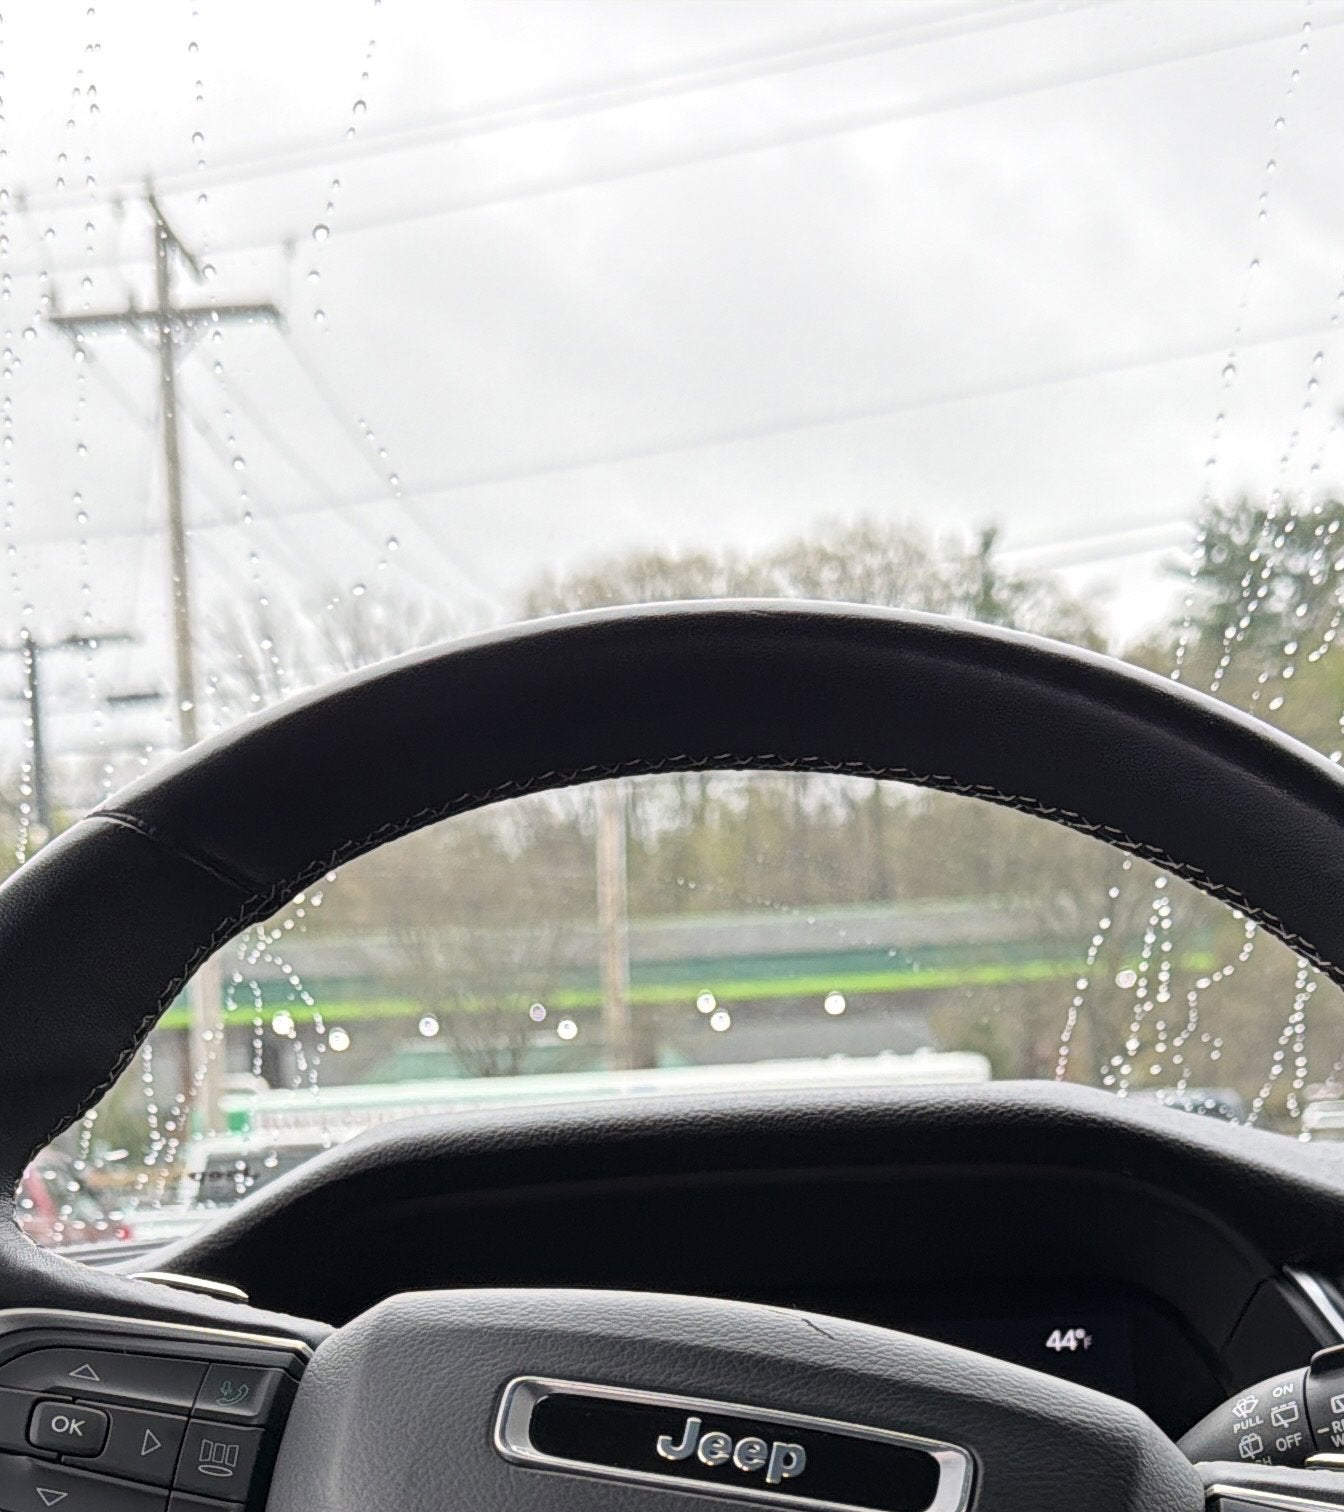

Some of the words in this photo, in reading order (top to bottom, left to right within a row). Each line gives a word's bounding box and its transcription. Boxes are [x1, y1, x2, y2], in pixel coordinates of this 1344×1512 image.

[1272, 1383, 1294, 1398] ON
[51, 1415, 85, 1436] OK
[1233, 1416, 1264, 1434] PULL
[657, 1416, 806, 1484] Jeep
[1275, 1432, 1303, 1452] OFF
